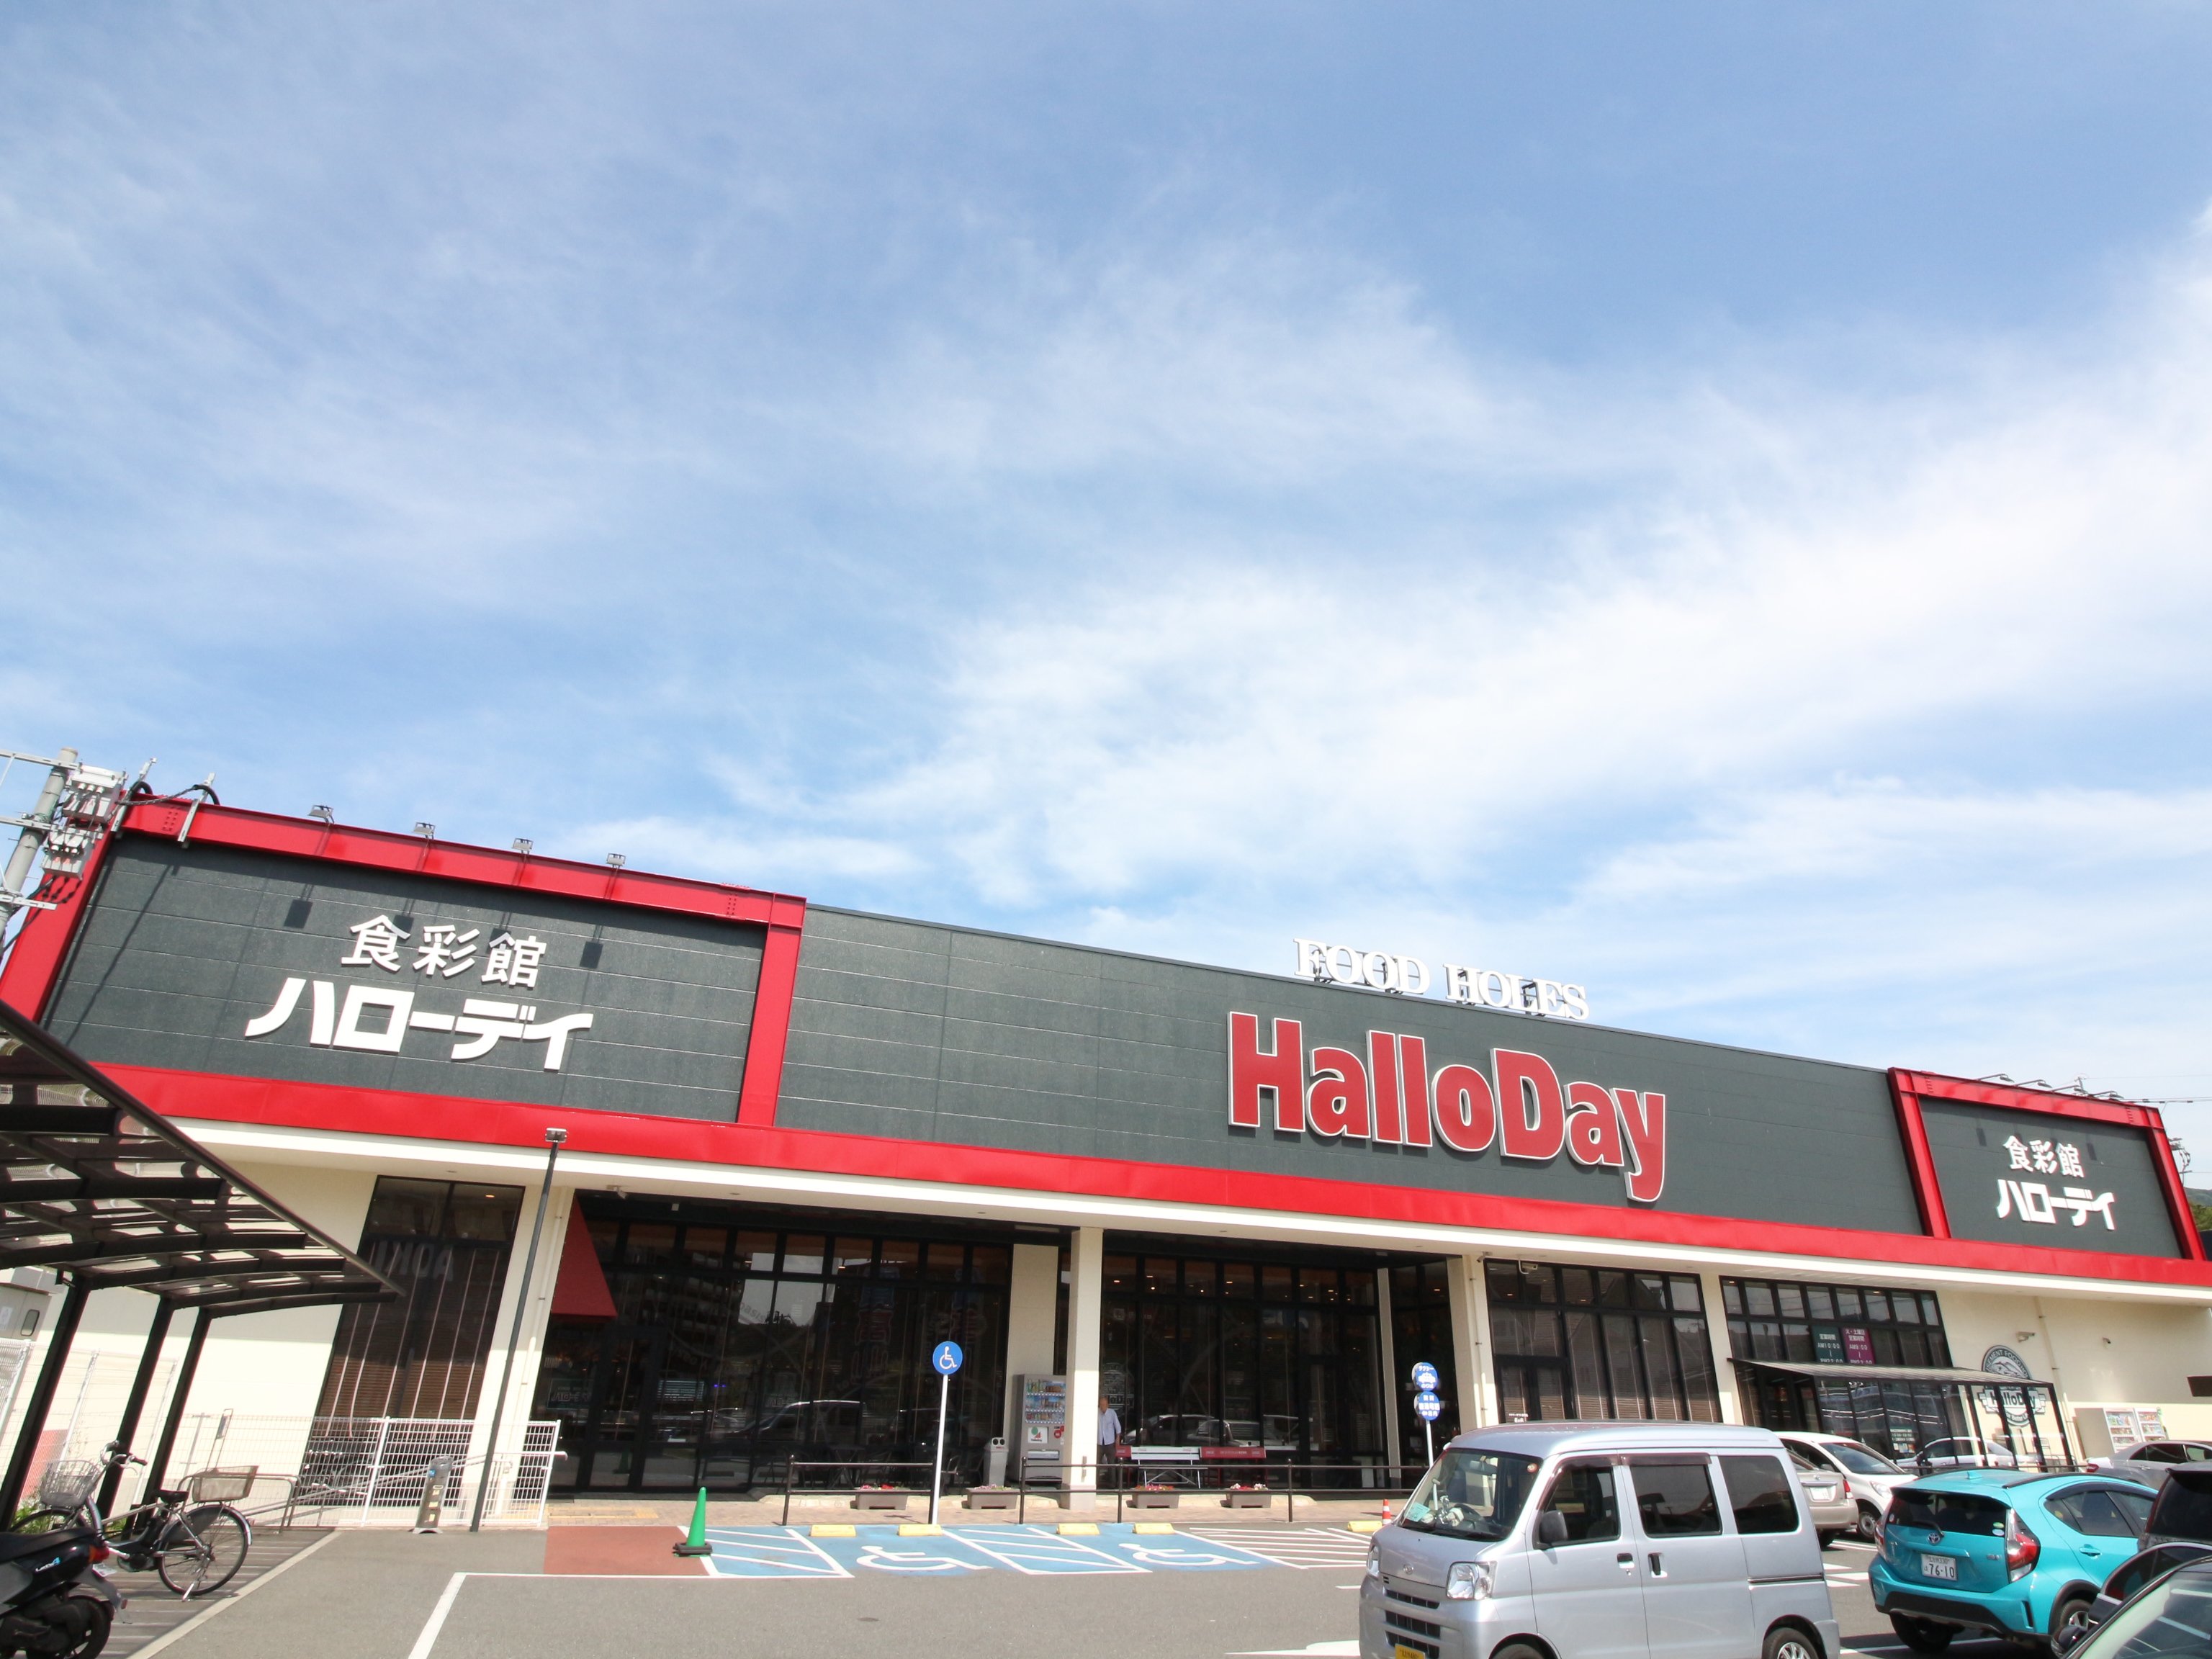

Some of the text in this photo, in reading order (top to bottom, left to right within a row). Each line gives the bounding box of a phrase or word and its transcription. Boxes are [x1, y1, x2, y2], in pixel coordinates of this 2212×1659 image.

[341, 914, 547, 989] 食彩館
[1293, 938, 1589, 1020] FOOD HOLES
[1227, 1011, 1666, 1202] HalloDay
[2002, 1135, 2085, 1178] 食彩館
[1928, 1563, 1955, 1578] 76-10
